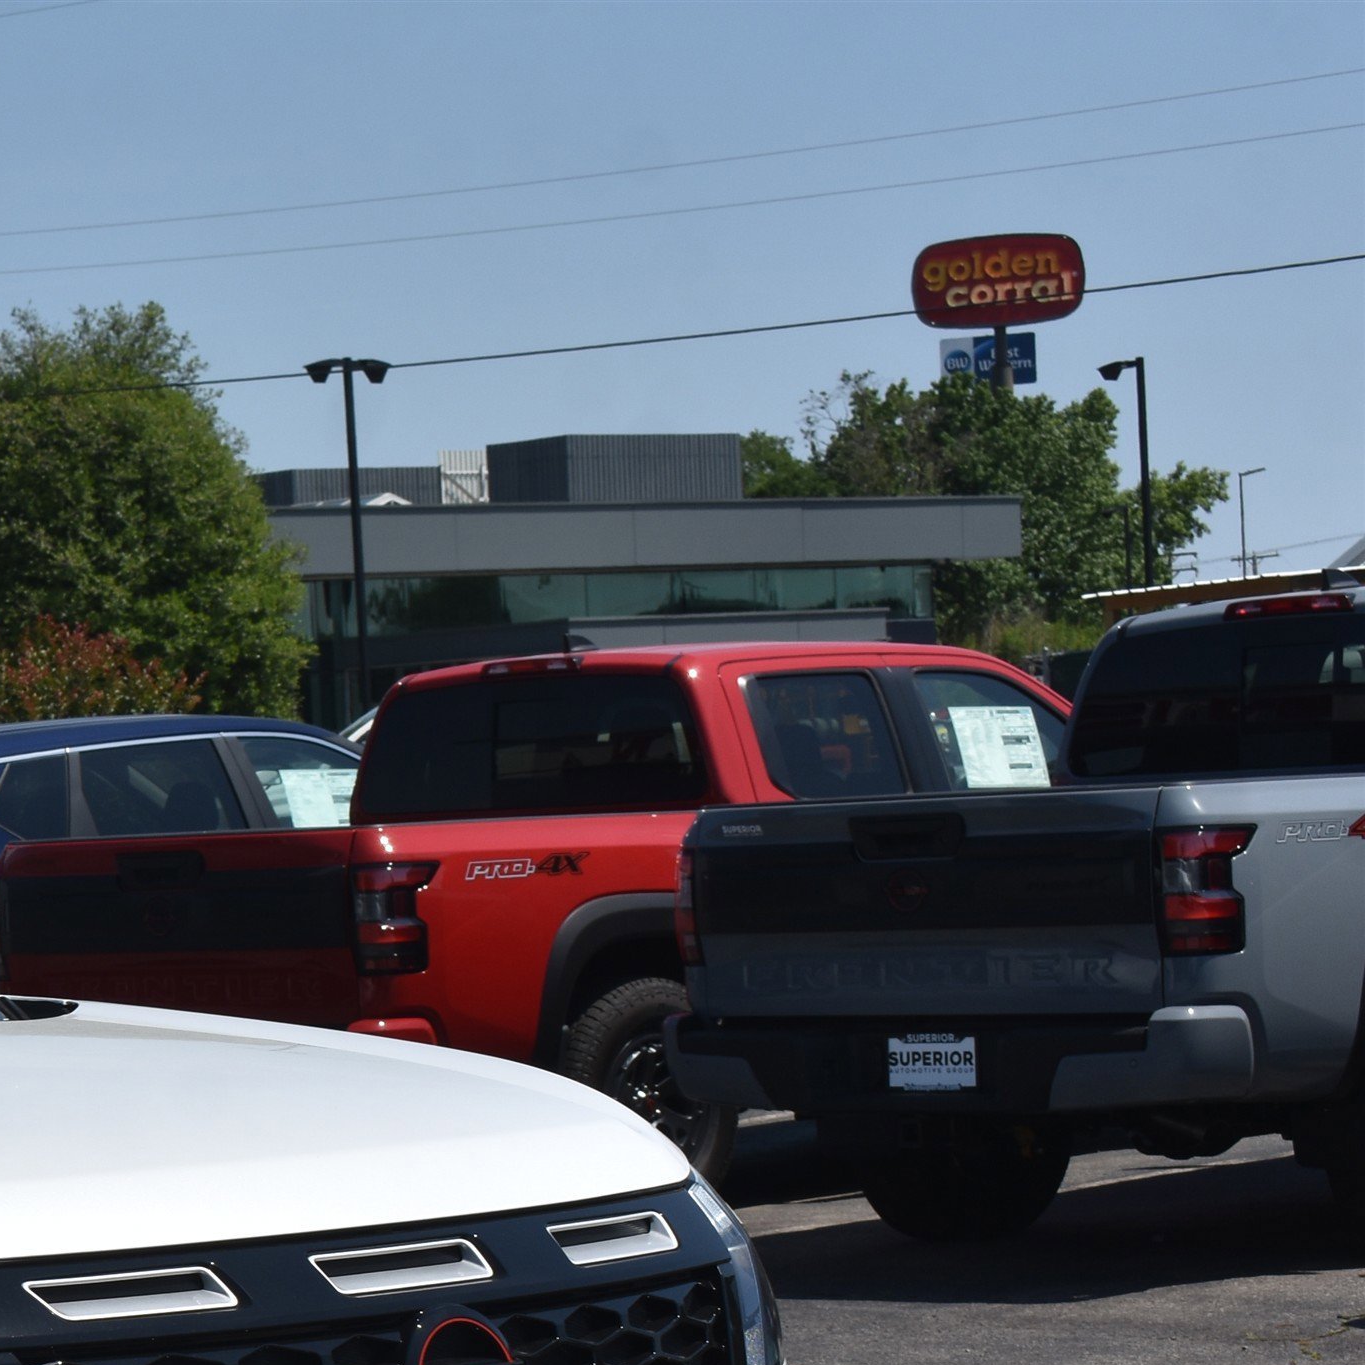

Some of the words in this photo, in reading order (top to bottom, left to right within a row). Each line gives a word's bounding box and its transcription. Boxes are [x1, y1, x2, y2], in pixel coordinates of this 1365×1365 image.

[922, 248, 1059, 292] golden
[945, 271, 1075, 307] corral
[906, 1032, 956, 1043] SUPERIOR
[888, 1051, 973, 1066] SUPERIOR
